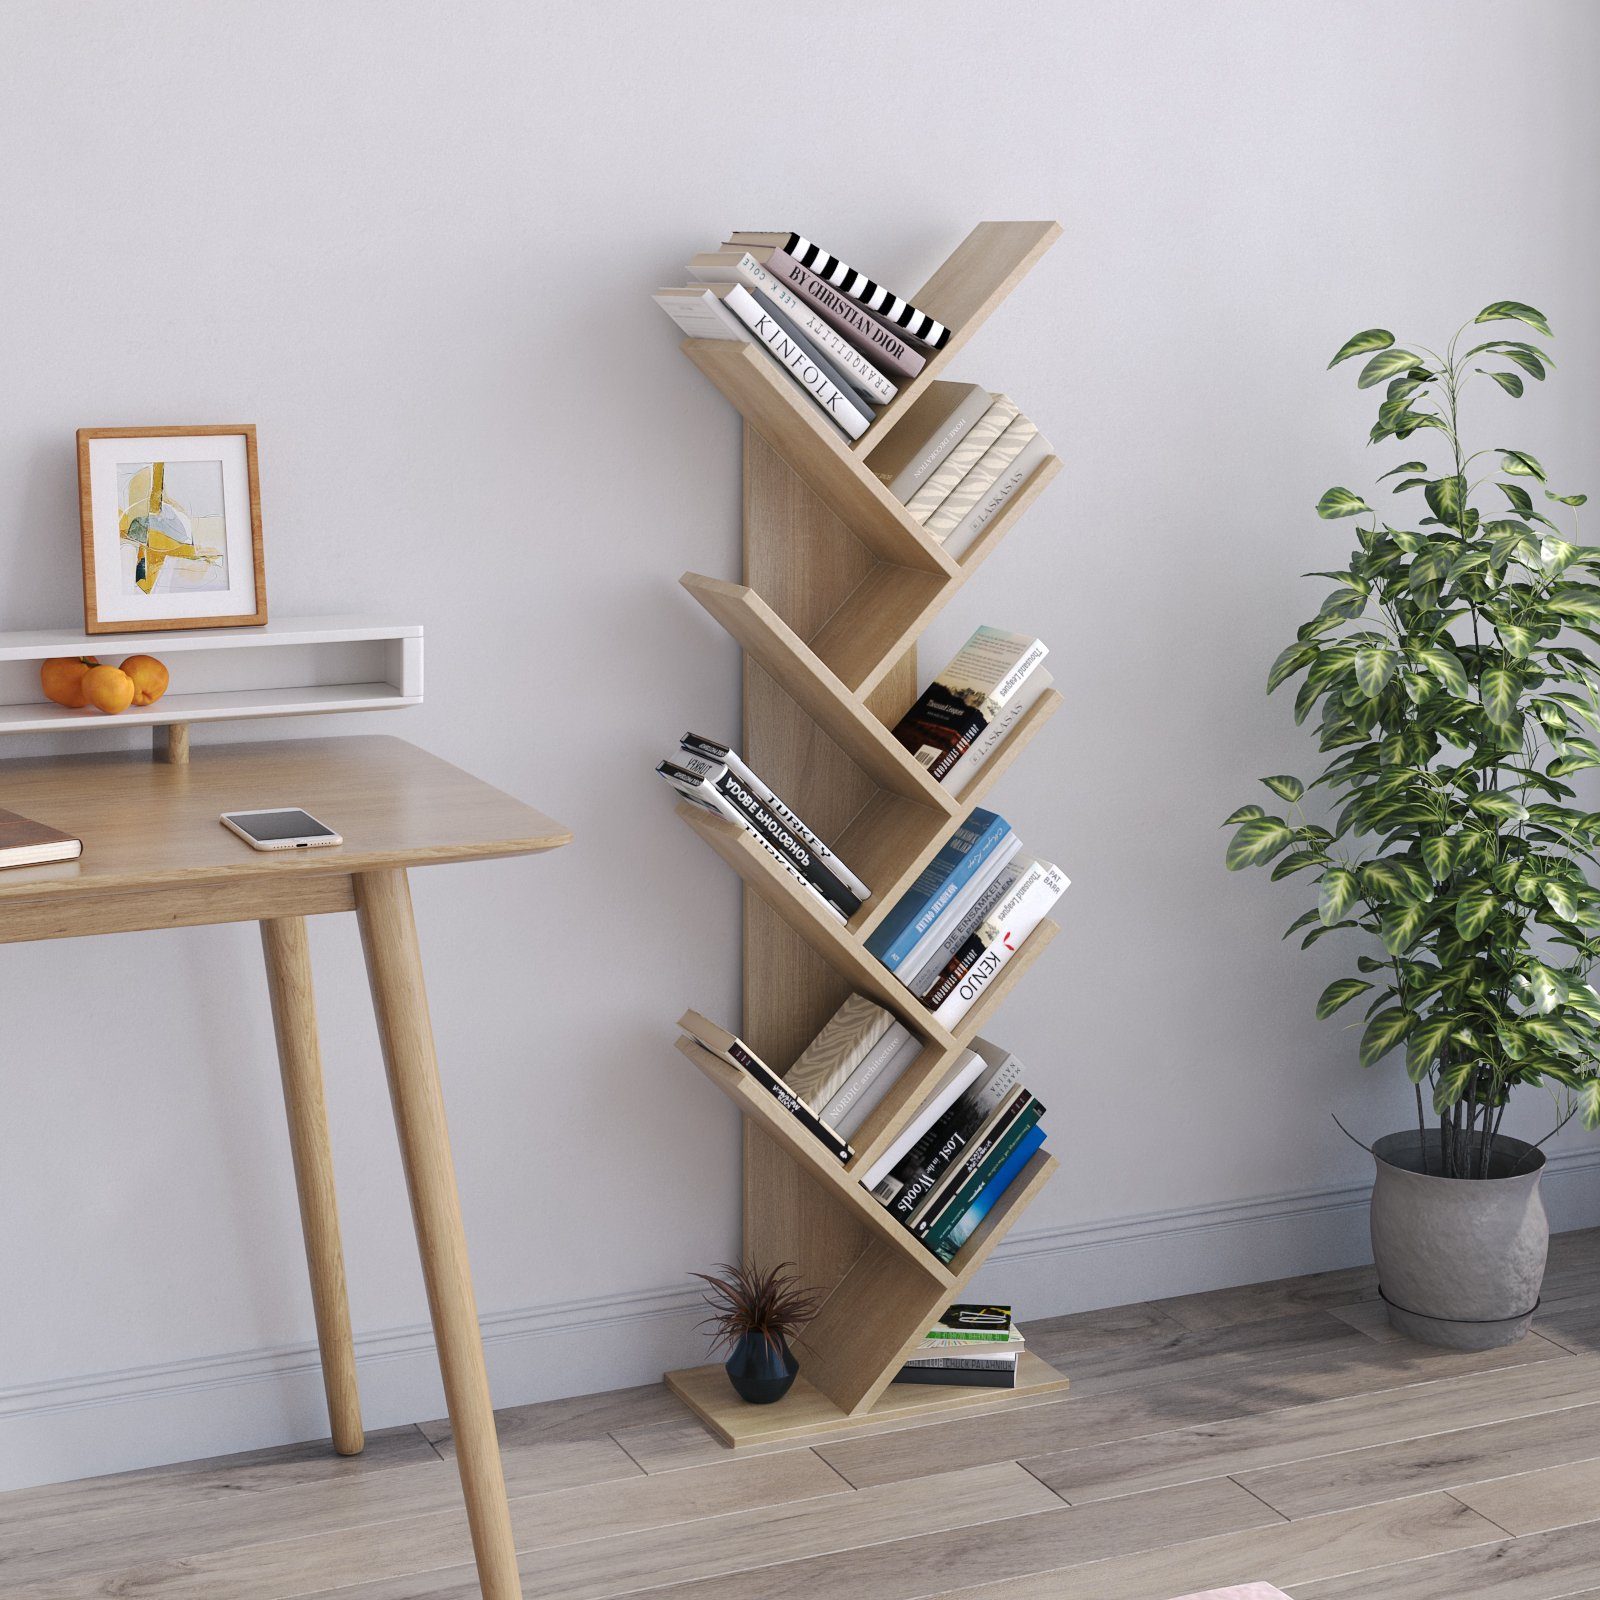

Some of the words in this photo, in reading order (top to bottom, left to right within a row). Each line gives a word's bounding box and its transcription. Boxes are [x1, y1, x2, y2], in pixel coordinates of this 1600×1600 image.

[742, 258, 766, 280] COLE
[779, 292, 796, 310] LEE
[789, 265, 810, 286] BY
[808, 280, 874, 337] CHRISTIAN
[869, 328, 906, 360] DIOR
[754, 314, 844, 414] KINFOLK
[804, 316, 890, 396] TRANQUILITY
[978, 471, 1024, 523] LASKASAS
[1019, 647, 1043, 674] Thousand
[999, 673, 1021, 698] Leagues
[978, 702, 1024, 757] LASKASAS
[1014, 870, 1041, 902] Thousand
[1043, 876, 1061, 894] BARR
[1049, 870, 1062, 882] PAT
[943, 933, 958, 950] DIE
[957, 879, 1003, 934] EINSAMKEIT
[997, 898, 1018, 922] Leagues
[959, 950, 1001, 1001] KENJO
[829, 1083, 862, 1120] NORDIC
[860, 1037, 900, 1084] architecture
[989, 1062, 1016, 1094] NAVINA
[995, 1066, 1021, 1099] MARVIN
[938, 1131, 967, 1160] Lost
[922, 1164, 936, 1174] the
[898, 1173, 936, 1212] Woods
